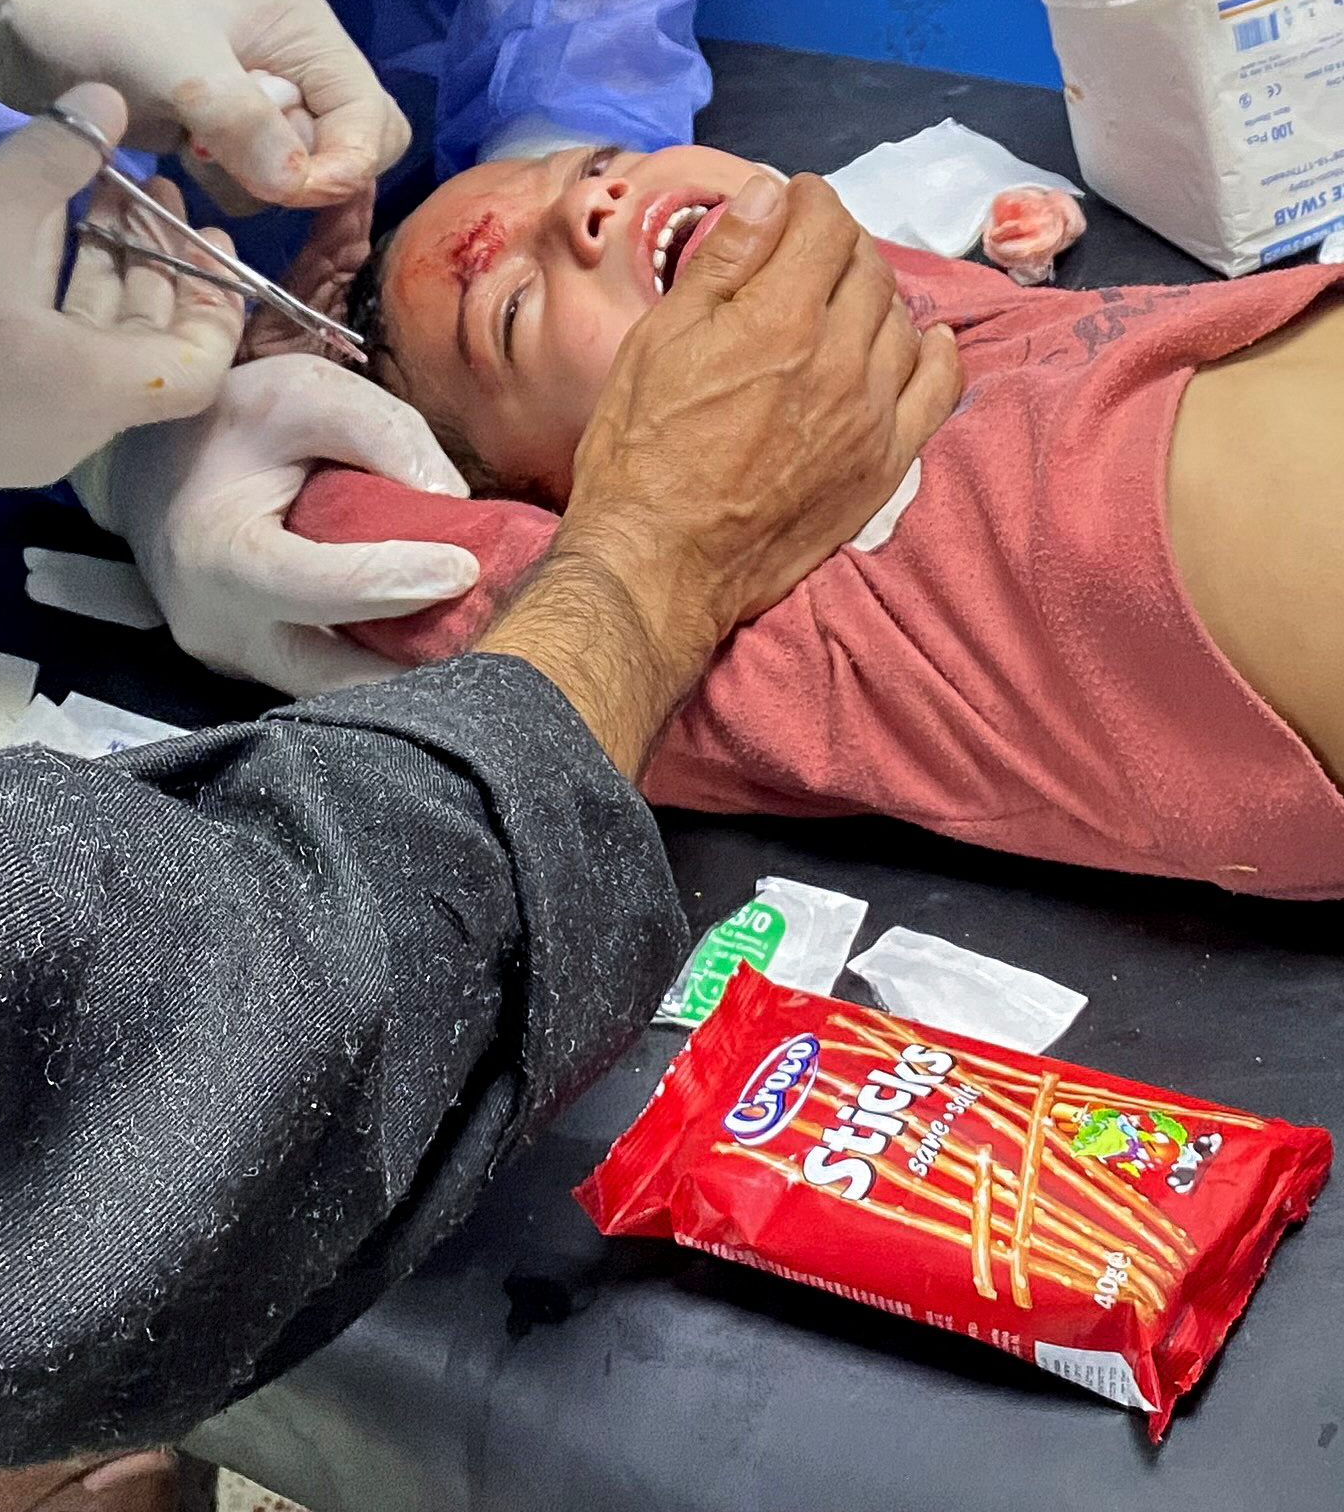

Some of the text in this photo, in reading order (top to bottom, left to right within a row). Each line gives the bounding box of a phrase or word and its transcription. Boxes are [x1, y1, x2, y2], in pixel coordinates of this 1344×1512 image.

[1266, 82, 1283, 98] CE
[1271, 120, 1295, 140] 100
[1273, 190, 1327, 227] SWAB
[722, 1036, 820, 1140] Croco
[803, 1044, 955, 1201] Sticks
[908, 1082, 983, 1178] sare salt
